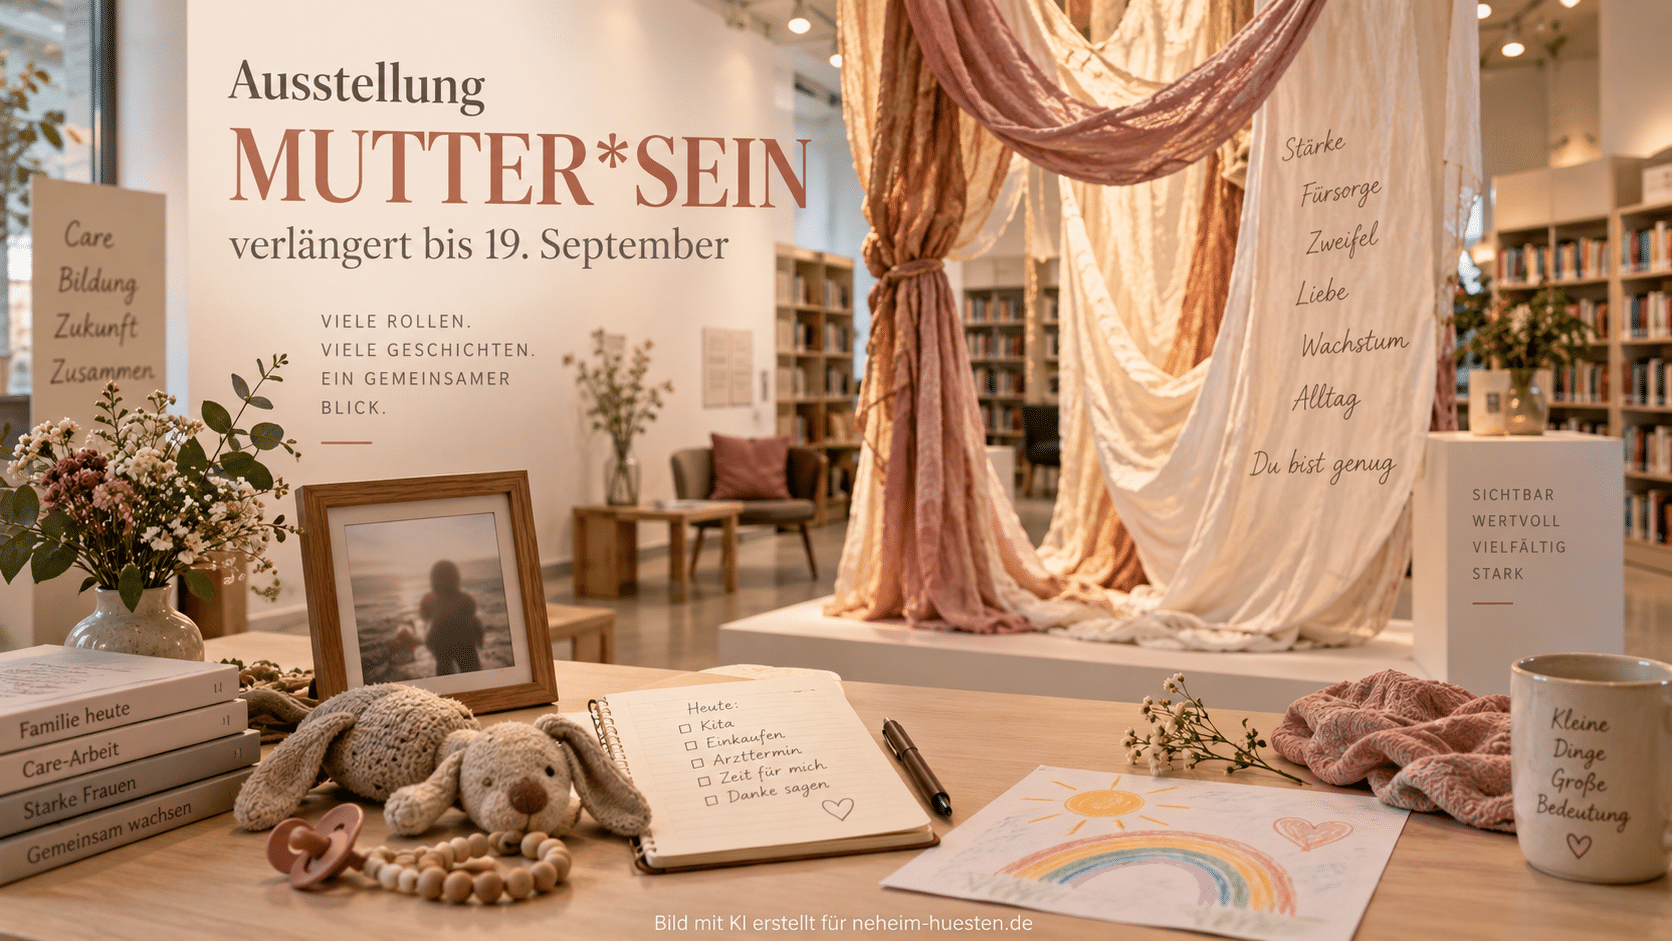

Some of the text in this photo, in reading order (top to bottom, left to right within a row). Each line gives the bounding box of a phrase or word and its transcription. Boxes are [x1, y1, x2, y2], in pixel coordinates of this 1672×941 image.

[227, 59, 486, 117] Ausstellung
[1282, 128, 1346, 162] Stärke
[1301, 180, 1383, 209] Fürsorge
[64, 219, 115, 250] Care
[228, 225, 730, 270] verlängert bis 19. September
[1305, 220, 1379, 259] Zweifel
[58, 265, 139, 306] Bildung
[1296, 277, 1350, 307] Liebe
[53, 312, 140, 347] Zukunft
[320, 313, 471, 329] VIELE ROLLEN.
[320, 342, 535, 357] VIELE GESCHICHTEN.
[1303, 328, 1410, 358] Wachstum
[50, 358, 155, 385] Zusammen
[321, 371, 509, 386] EIN GEMEINSAMER
[321, 400, 386, 415] BLICK.
[1292, 383, 1362, 421] Alltag
[1250, 448, 1397, 486] Du bist genug
[1472, 488, 1554, 501] SICHTBAR
[1472, 514, 1560, 528] WERTVOLL
[1472, 538, 1566, 554] VIELFÄLTIG
[1472, 567, 1524, 580] STARK
[20, 703, 130, 739] Familie heute
[687, 700, 739, 715] Heute:
[1551, 707, 1610, 733] Kleine
[701, 718, 736, 732] Kita
[706, 728, 786, 748] Einkaufen
[22, 742, 120, 779] Care-Arbeit
[713, 745, 803, 766] Arzttermin
[1553, 737, 1607, 770] Dinge
[719, 759, 828, 784] Zeit für mich
[1551, 767, 1607, 798] Große
[23, 778, 137, 820] Starke Frauen
[728, 781, 830, 804] Danke sagen
[1537, 793, 1631, 833] Bedeutung
[27, 802, 192, 865] Gemeinsam wachsen
